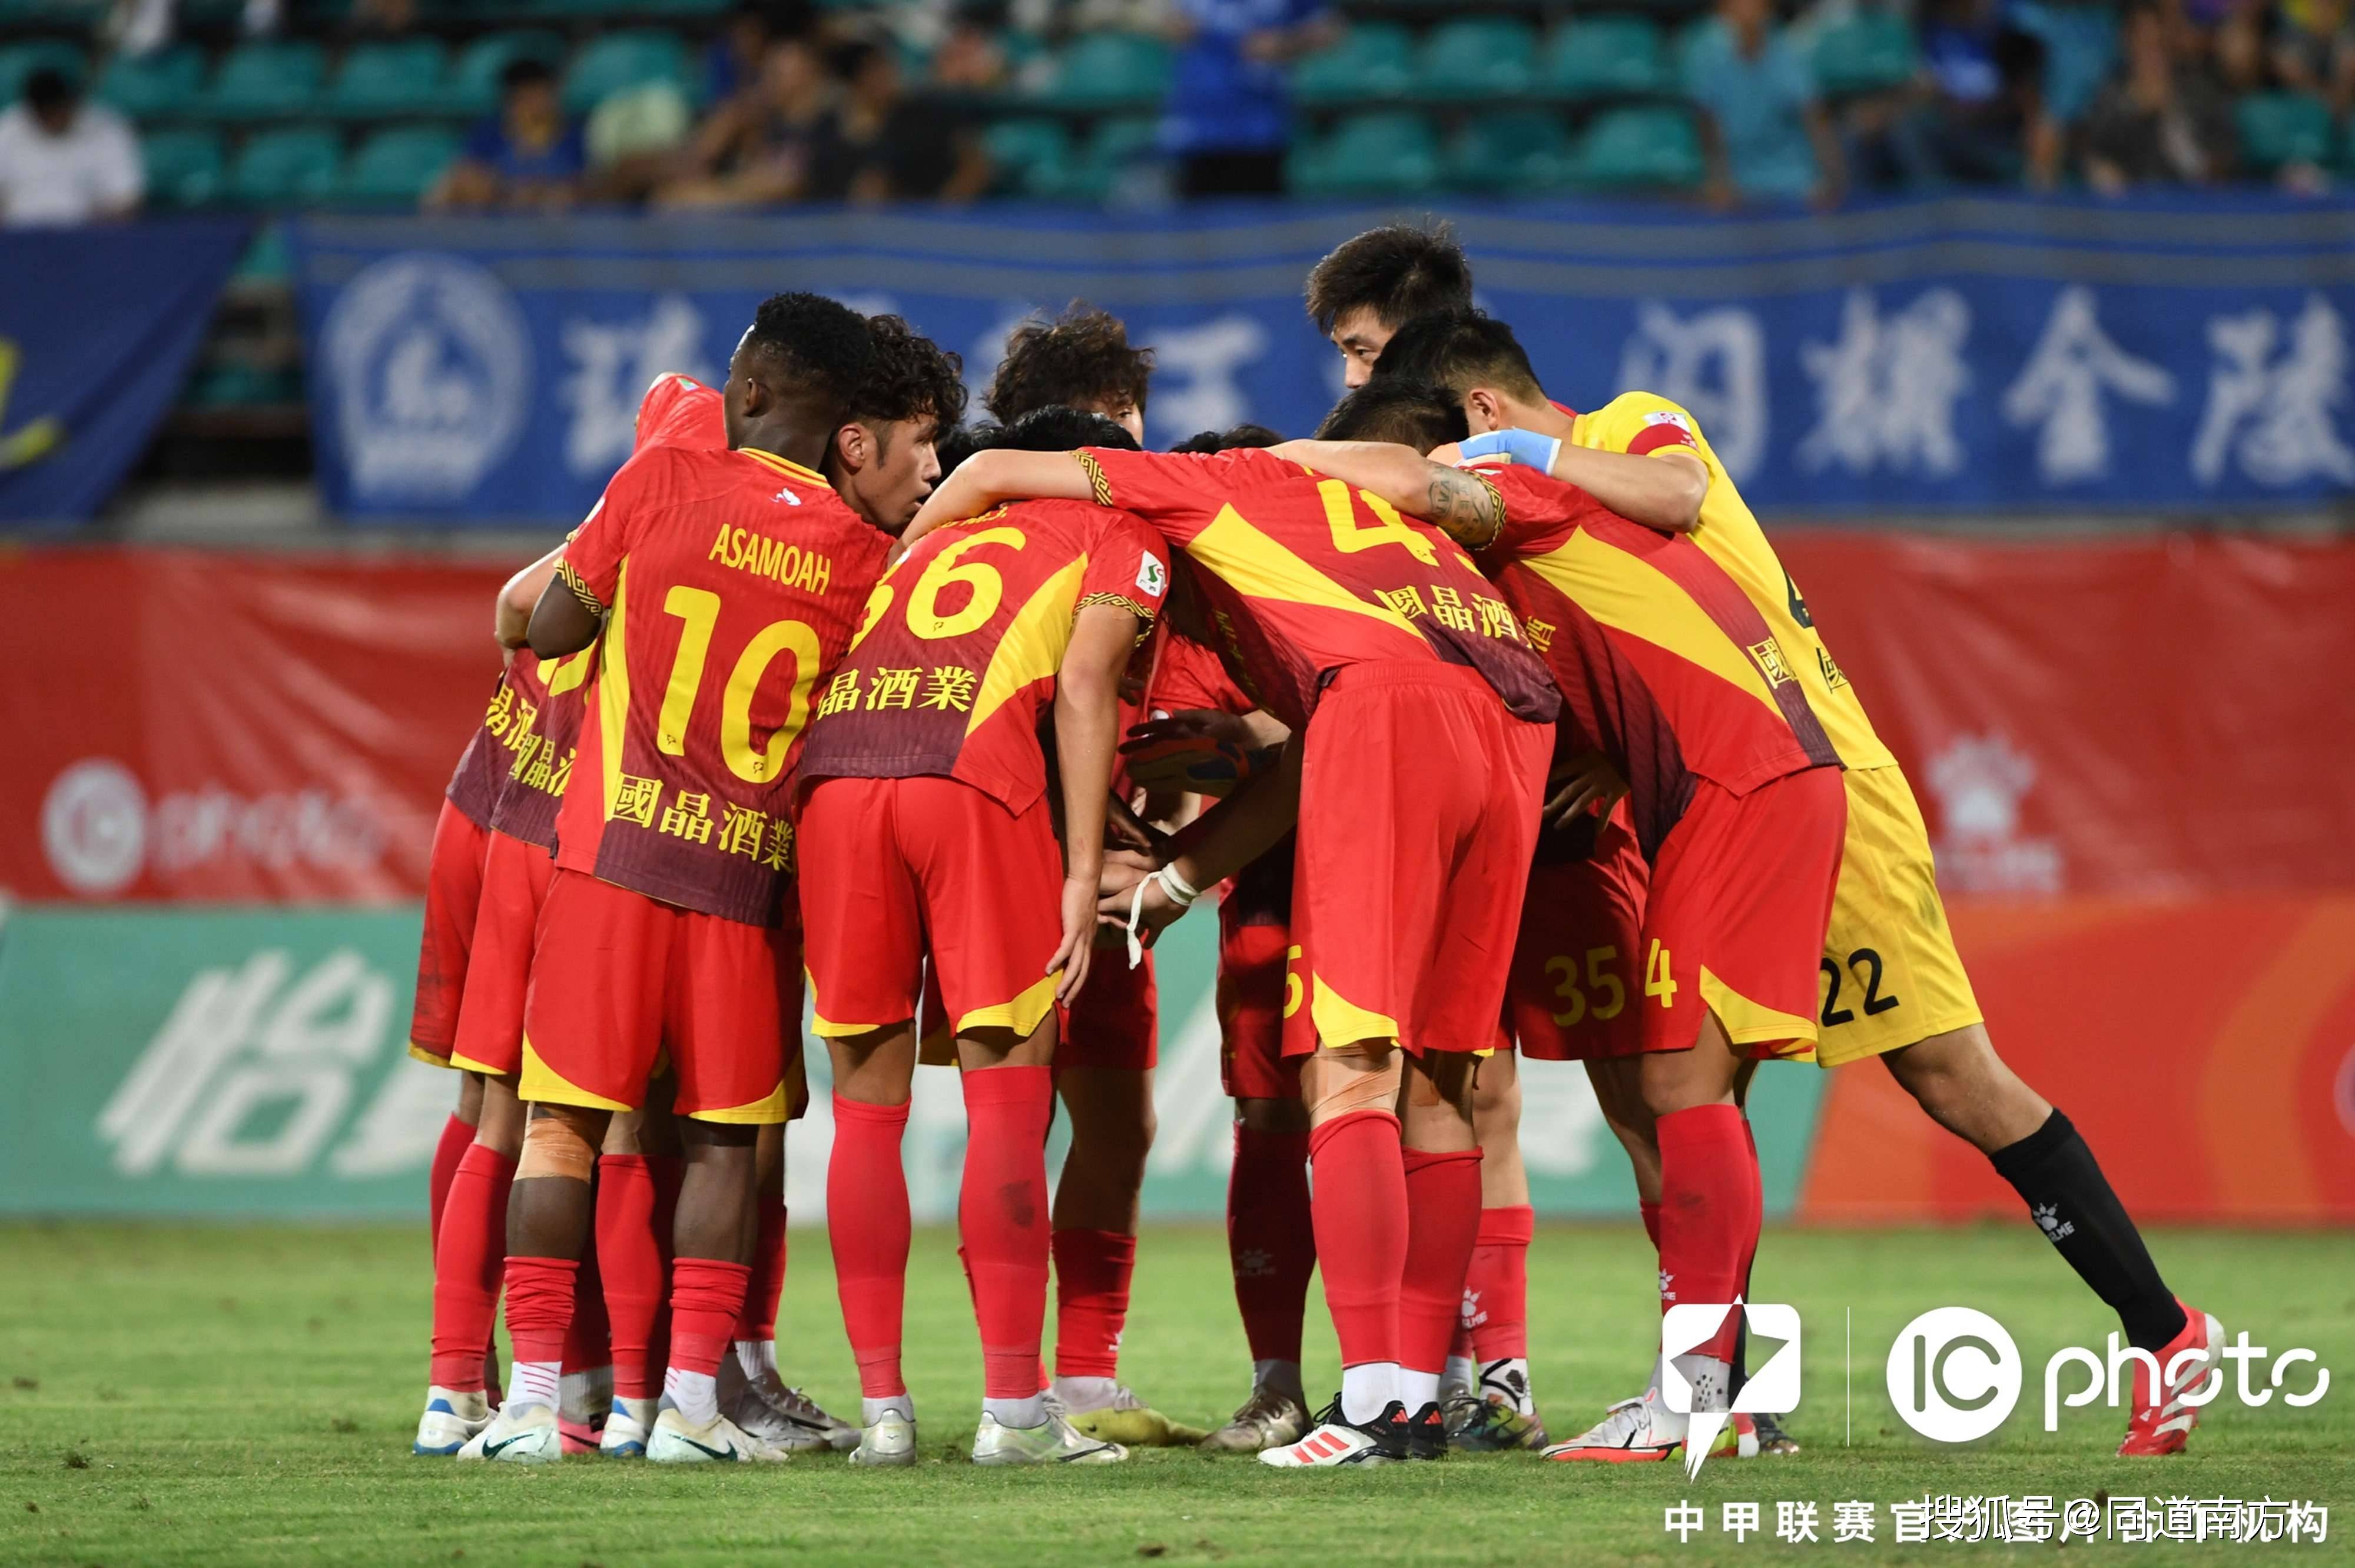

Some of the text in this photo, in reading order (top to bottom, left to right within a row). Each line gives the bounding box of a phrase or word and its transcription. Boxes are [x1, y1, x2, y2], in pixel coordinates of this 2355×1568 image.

[708, 523, 832, 596] ASAMOAH
[1317, 479, 1485, 579] 4
[1374, 584, 1533, 649] 國晶酒
[657, 585, 821, 784] 10
[817, 666, 978, 720] 晶酒業
[606, 772, 793, 872] 國晶酒業
[1544, 945, 1626, 1027] 35
[1645, 938, 1678, 1008] 4
[1820, 948, 1900, 1027] 22
[2048, 1221, 2075, 1242] ELME
